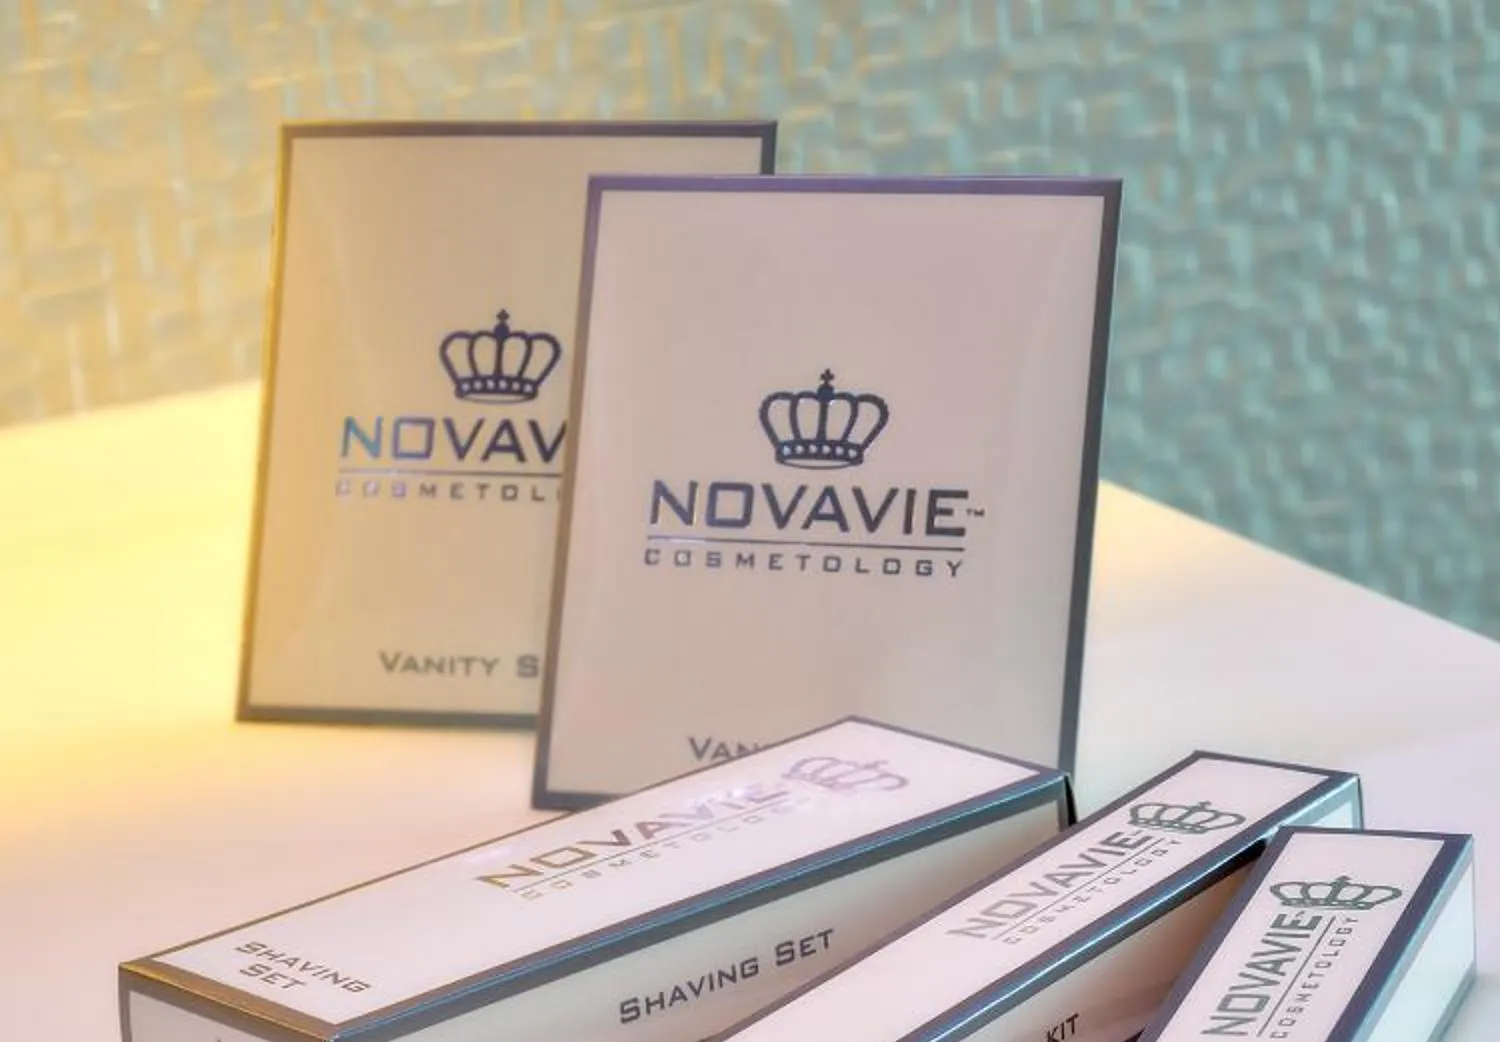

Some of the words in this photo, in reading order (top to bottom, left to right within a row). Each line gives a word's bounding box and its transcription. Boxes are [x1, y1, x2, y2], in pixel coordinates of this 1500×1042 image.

[340, 416, 566, 463] NOVAV
[335, 480, 560, 502] COSMETOL
[644, 549, 963, 577] COSMETOLOGY
[377, 650, 502, 677] VANITY
[686, 735, 760, 761] VAN
[474, 783, 790, 889] NOVAVIE
[520, 796, 811, 901] COSMETOLO
[1001, 840, 1181, 945] COSMETOLOGY
[234, 941, 372, 993] SHAVING
[239, 963, 306, 990] SET
[620, 957, 760, 1024] SHAVING
[774, 928, 834, 967] SET
[1269, 916, 1360, 1039] COSMETOLOGY
